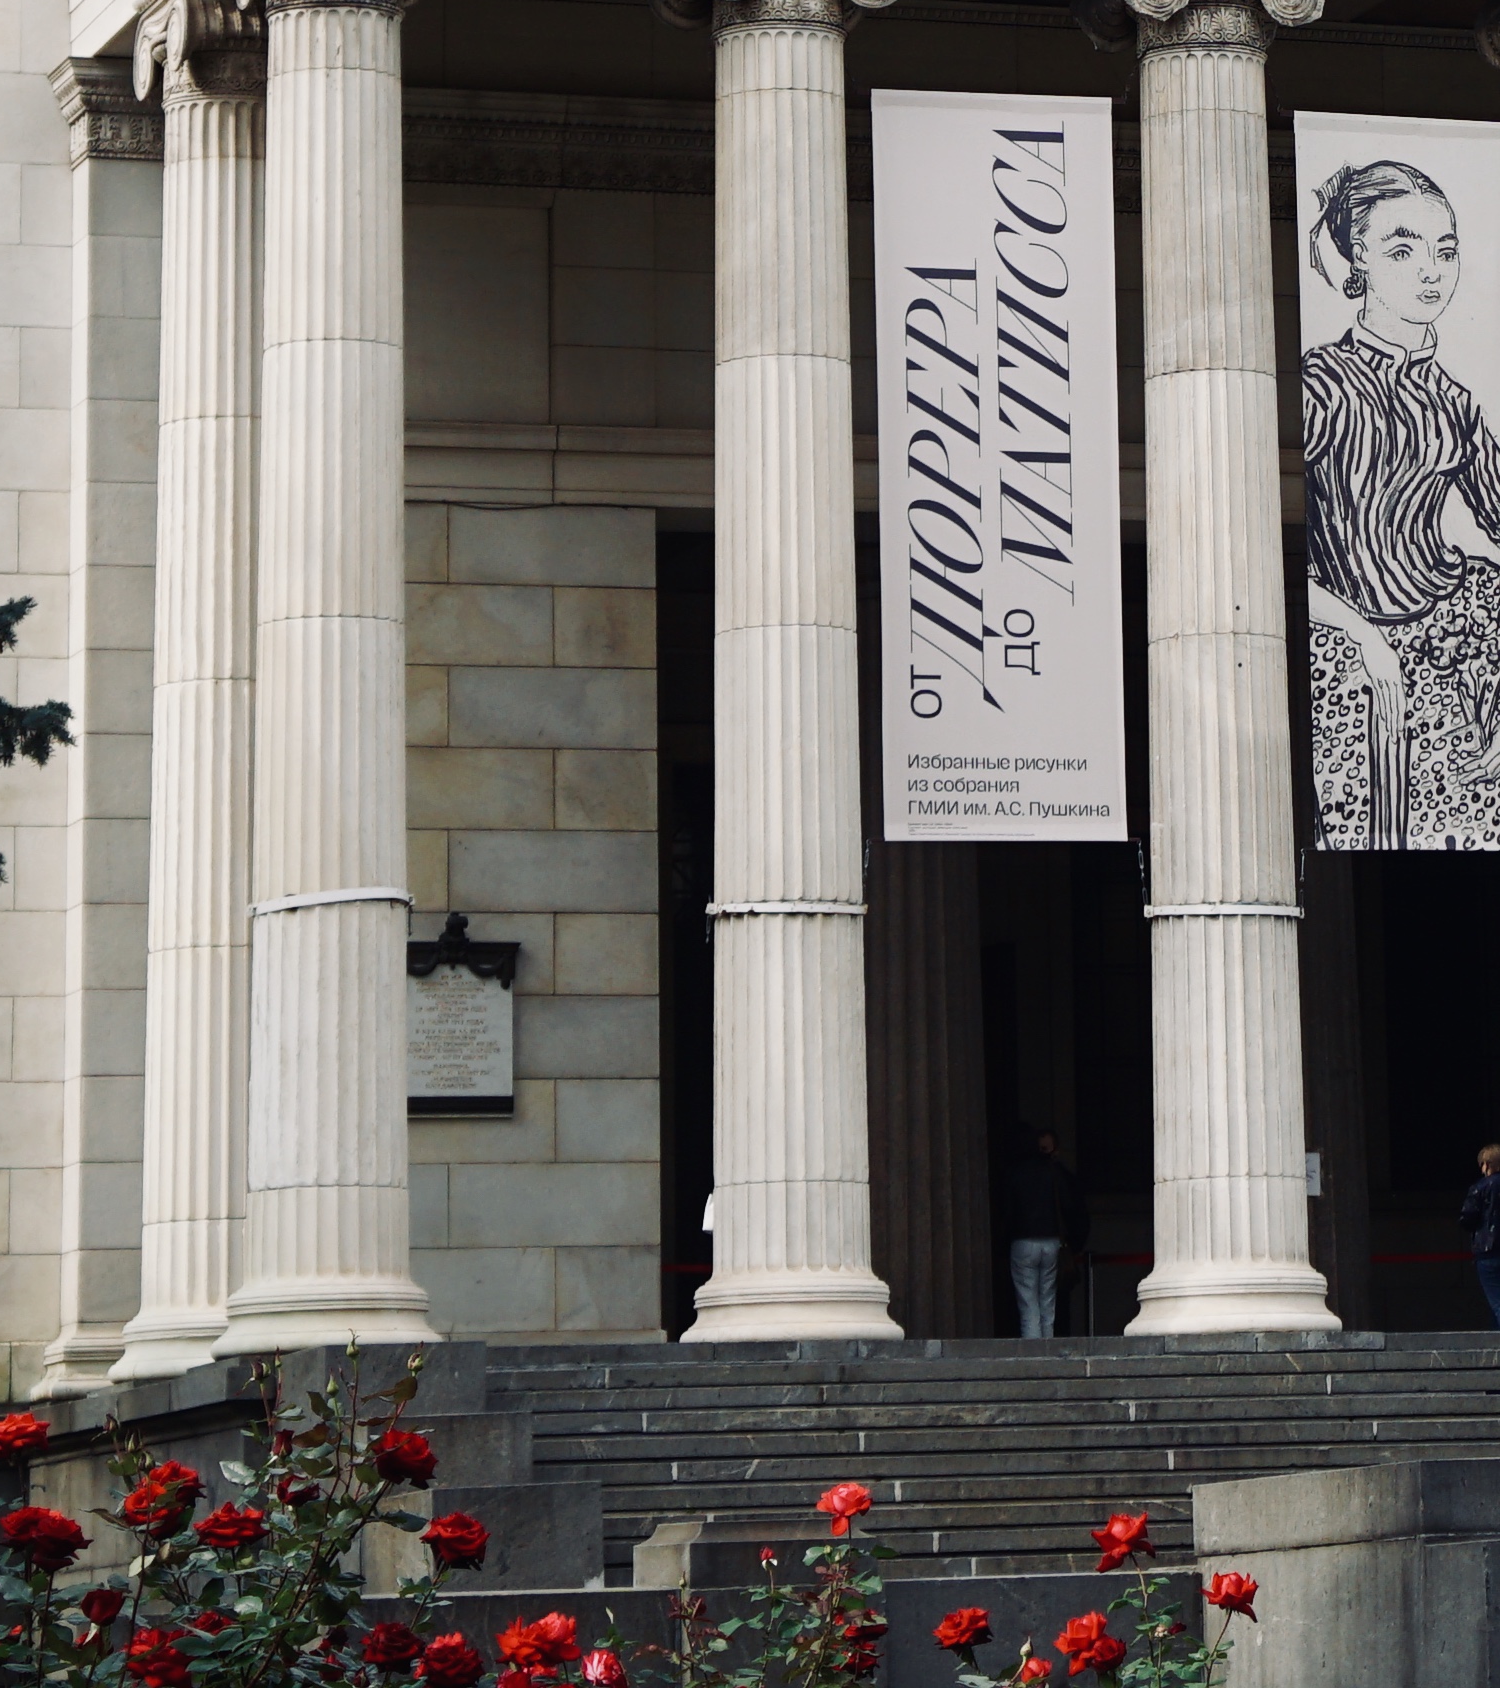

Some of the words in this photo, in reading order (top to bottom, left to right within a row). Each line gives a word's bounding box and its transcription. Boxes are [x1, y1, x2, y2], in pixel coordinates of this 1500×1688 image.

[991, 121, 1075, 606] МАТИССА
[903, 258, 1006, 713] ДЮРЕРА
[907, 753, 1010, 771] Избранные
[1014, 757, 1088, 773] рисунки
[907, 779, 928, 792] из
[933, 777, 1020, 795] собрания
[907, 800, 959, 815] ГМИИ
[963, 803, 991, 816] им.
[995, 801, 1026, 817] А.С.
[1029, 802, 1111, 819] Пушкина
